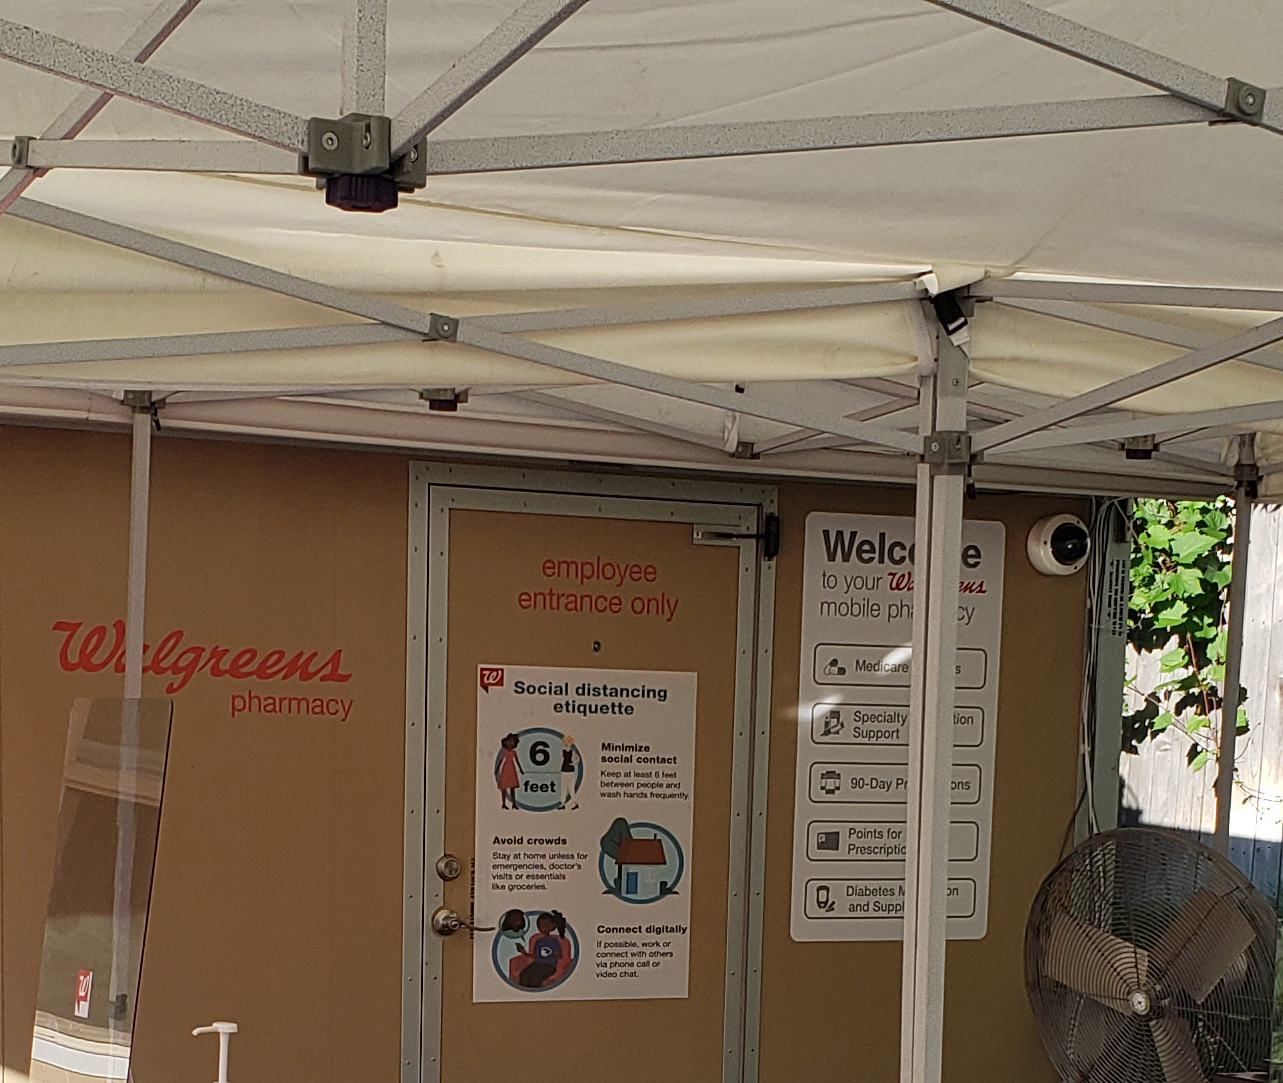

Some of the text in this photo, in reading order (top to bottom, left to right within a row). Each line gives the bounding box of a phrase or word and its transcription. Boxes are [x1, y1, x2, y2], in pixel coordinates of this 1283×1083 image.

[822, 529, 981, 568] Welce
[542, 555, 657, 587] employee
[822, 570, 838, 589] to
[844, 574, 882, 594] your
[518, 587, 679, 622] entrance only
[820, 597, 975, 626] mobile phcy
[855, 659, 909, 673] Medicare
[513, 681, 668, 702] Social distancing
[231, 690, 354, 722] pharmacy
[553, 701, 635, 716] etiquette
[853, 710, 908, 726] Specialty
[852, 727, 900, 741] Support
[601, 742, 650, 752] Minimize
[529, 741, 550, 766] 6
[600, 754, 677, 764] social contact
[600, 770, 622, 779] Keep
[523, 780, 556, 792] feet
[600, 780, 635, 788] between
[637, 781, 664, 790] people
[850, 777, 892, 792] 90-Day
[623, 791, 648, 799] hands
[848, 828, 902, 840] Points for
[492, 836, 567, 845] Avoid crowds
[492, 852, 588, 861] Stay at home unless for
[492, 862, 582, 871] emergencies, doctor's
[508, 883, 548, 892] groceries.
[846, 886, 895, 896] Diabetes
[848, 902, 870, 912] and
[597, 925, 688, 934] Connect digitally
[610, 960, 634, 969] phone
[636, 960, 650, 968] call
[596, 970, 618, 978] video
